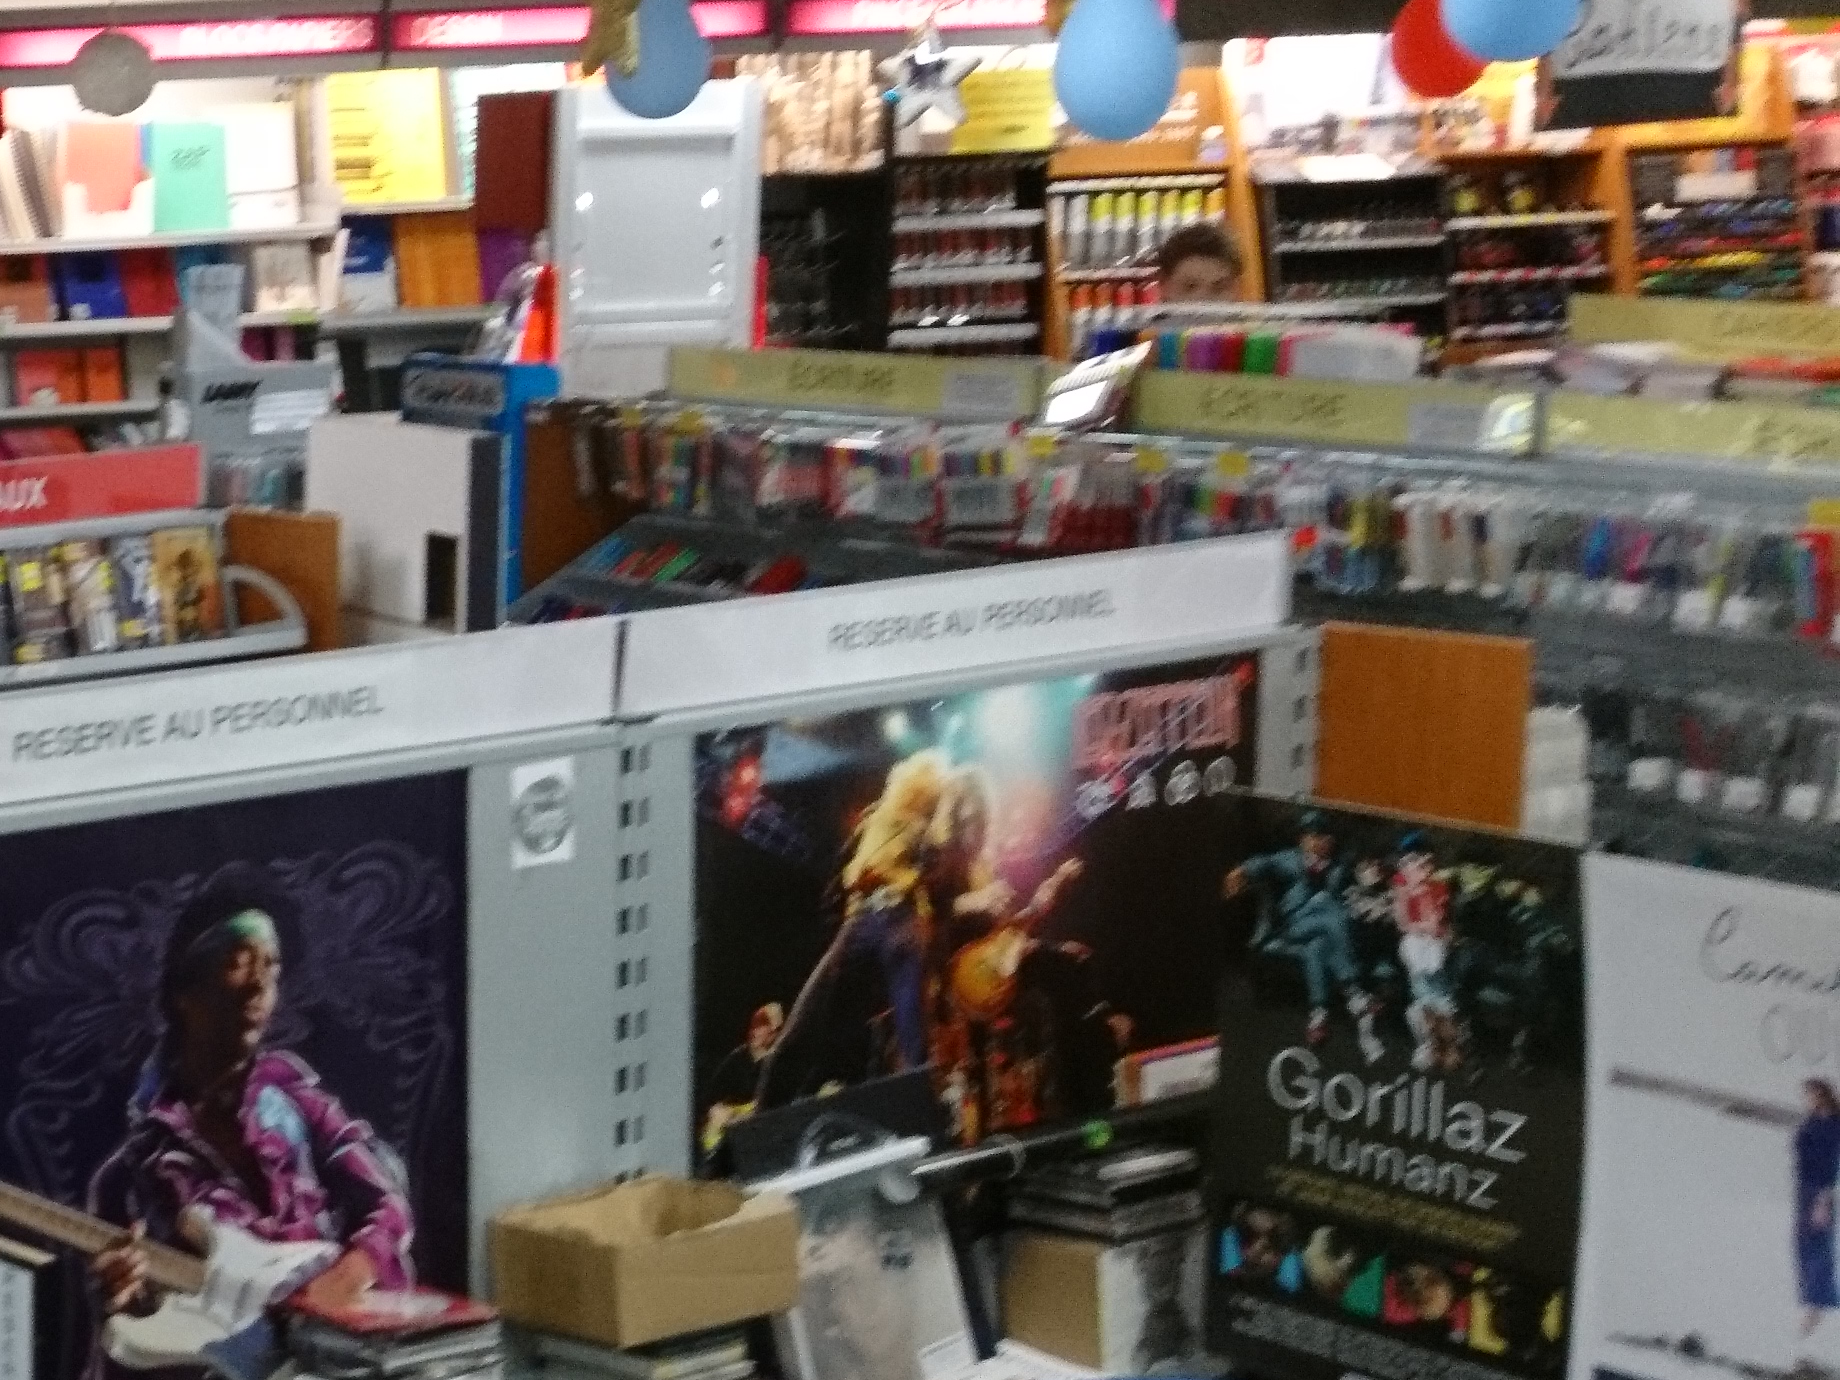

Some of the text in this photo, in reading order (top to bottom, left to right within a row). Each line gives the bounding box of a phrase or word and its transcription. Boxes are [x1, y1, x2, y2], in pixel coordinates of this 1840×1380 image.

[11, 685, 386, 763] RESERVE AU PERSONNEL
[1265, 1044, 1533, 1163] Gorillaz
[1287, 1113, 1503, 1212] Humanz
